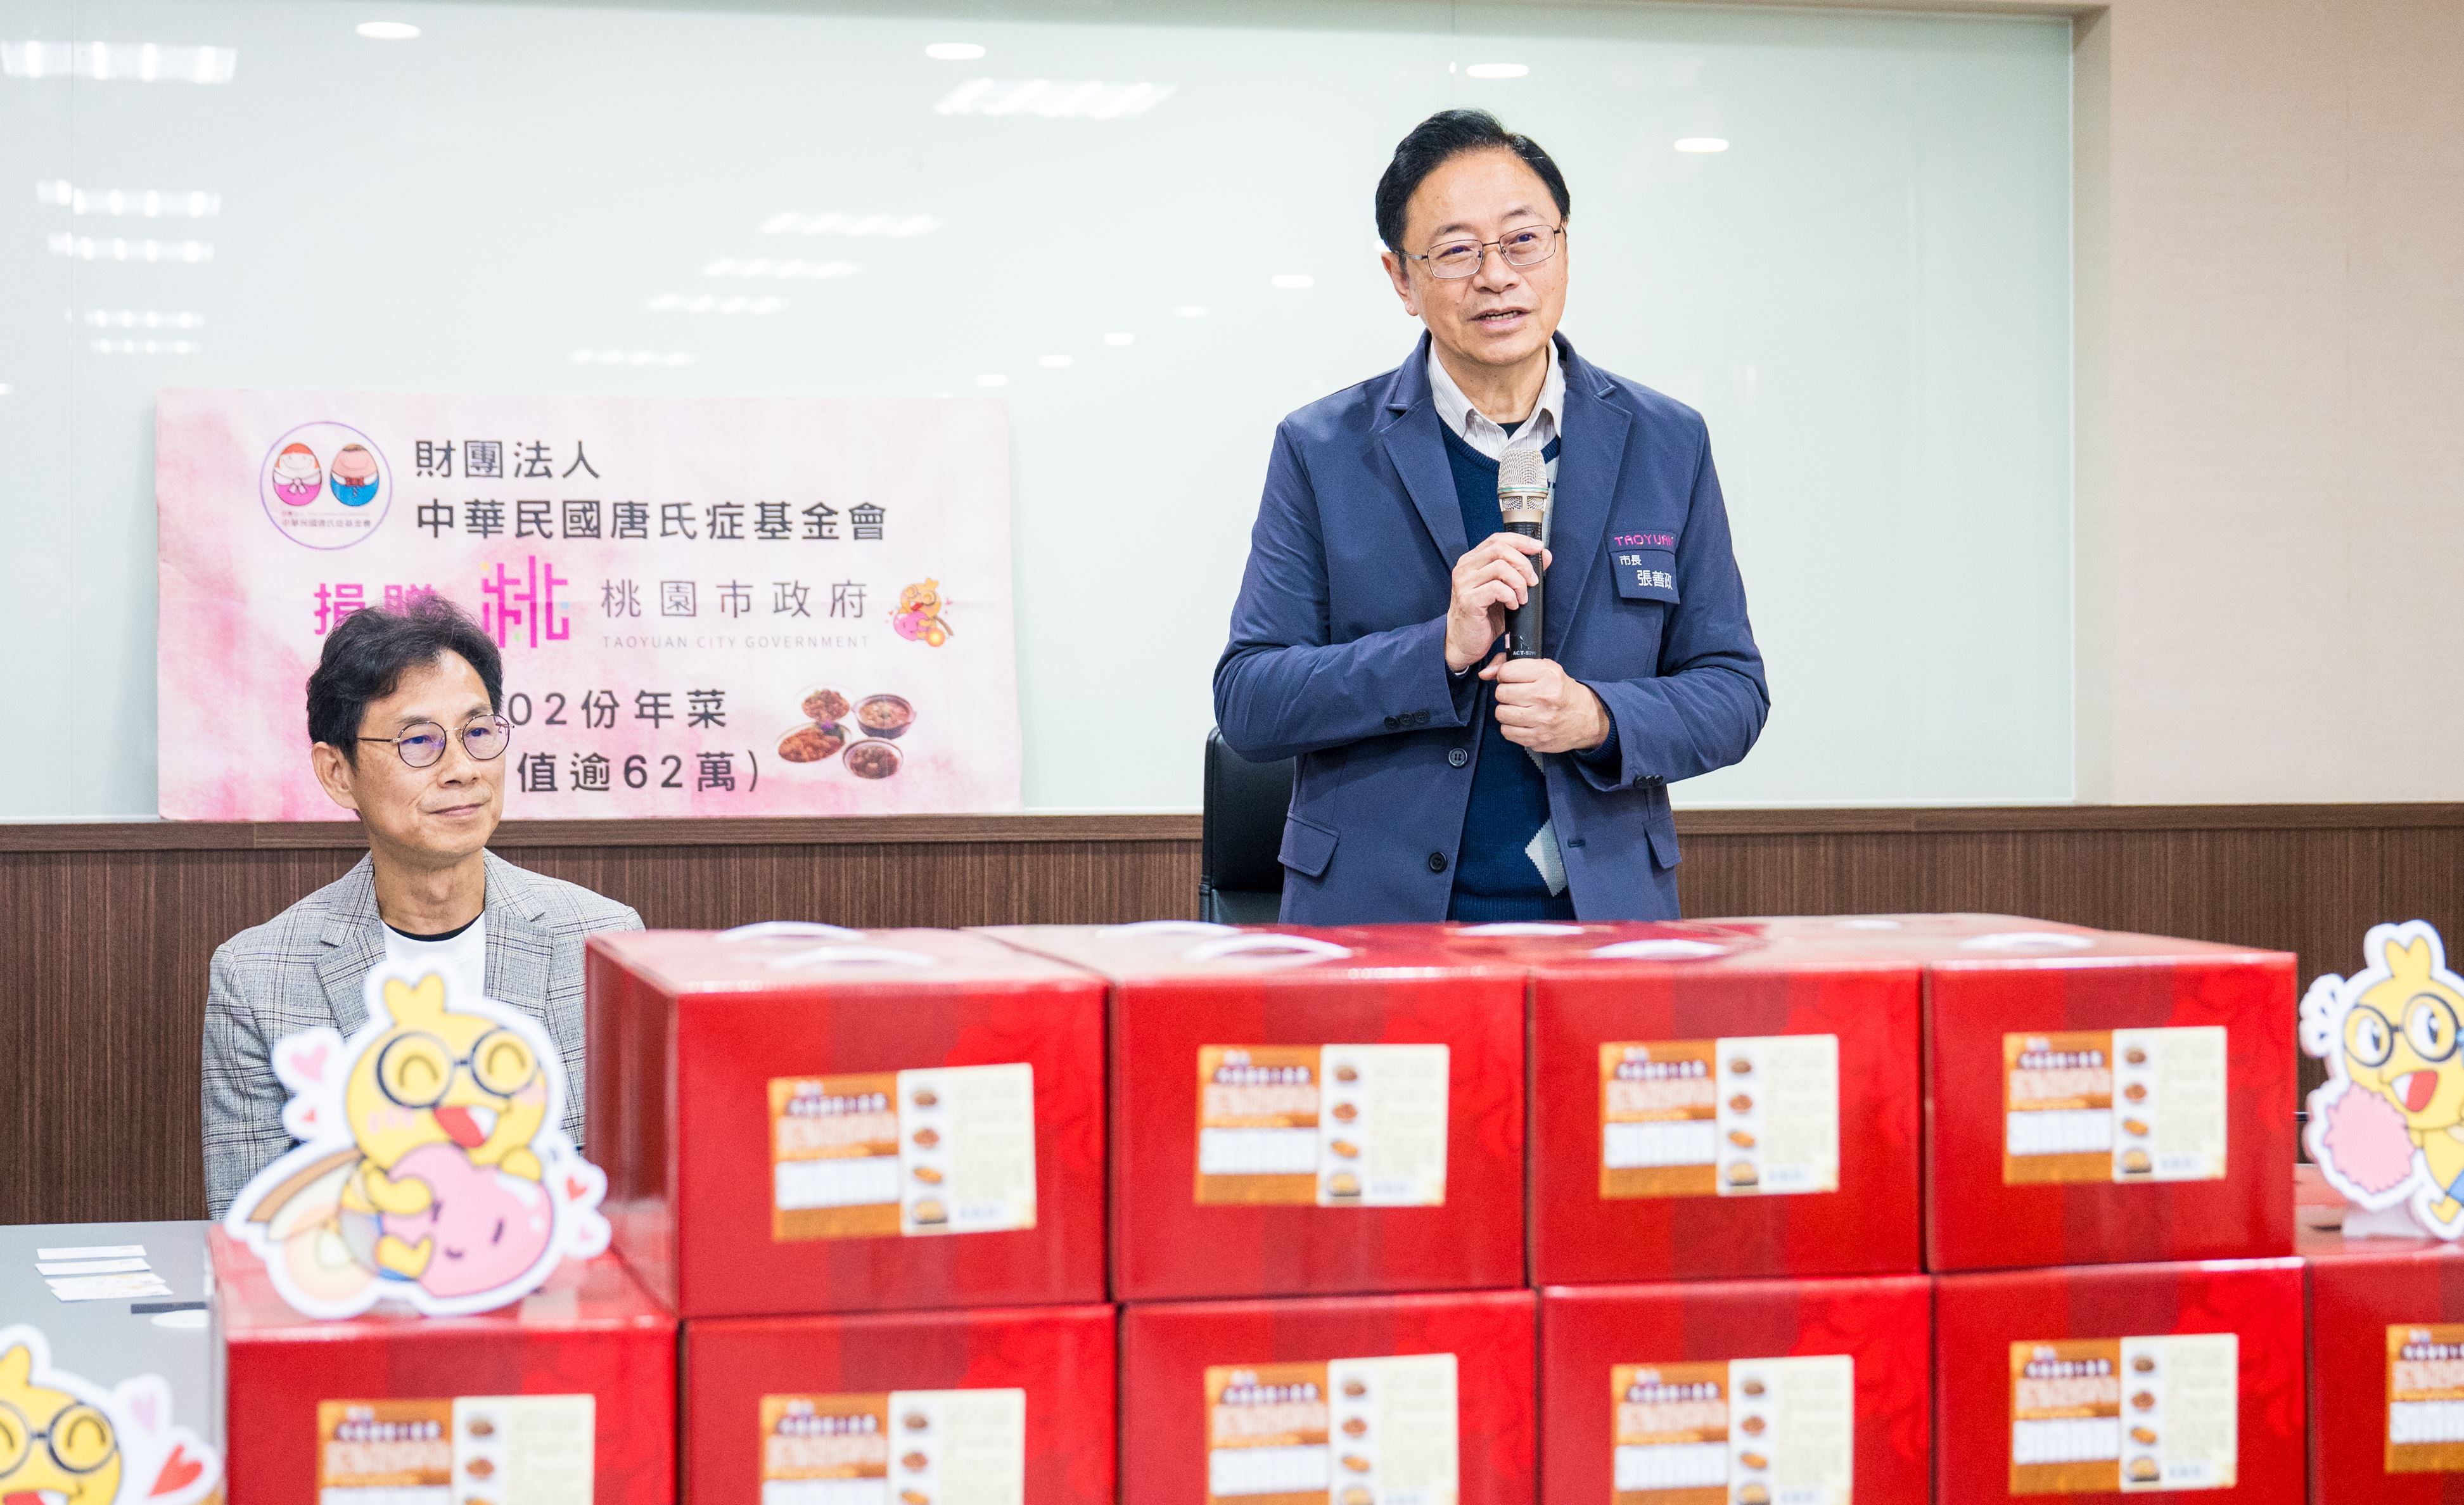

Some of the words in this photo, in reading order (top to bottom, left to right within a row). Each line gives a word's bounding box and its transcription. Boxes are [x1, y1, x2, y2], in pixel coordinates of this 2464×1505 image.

[414, 440, 601, 479] 財團法人
[417, 499, 886, 541] 中華民國唐氏症基金會
[1619, 554, 1642, 566] 市長
[1637, 570, 1673, 590] 張善政
[601, 579, 867, 618] 桃園市政府
[603, 636, 687, 648] TAOYUAN
[697, 636, 736, 649] CITY
[745, 636, 869, 649] GOVERNMENT
